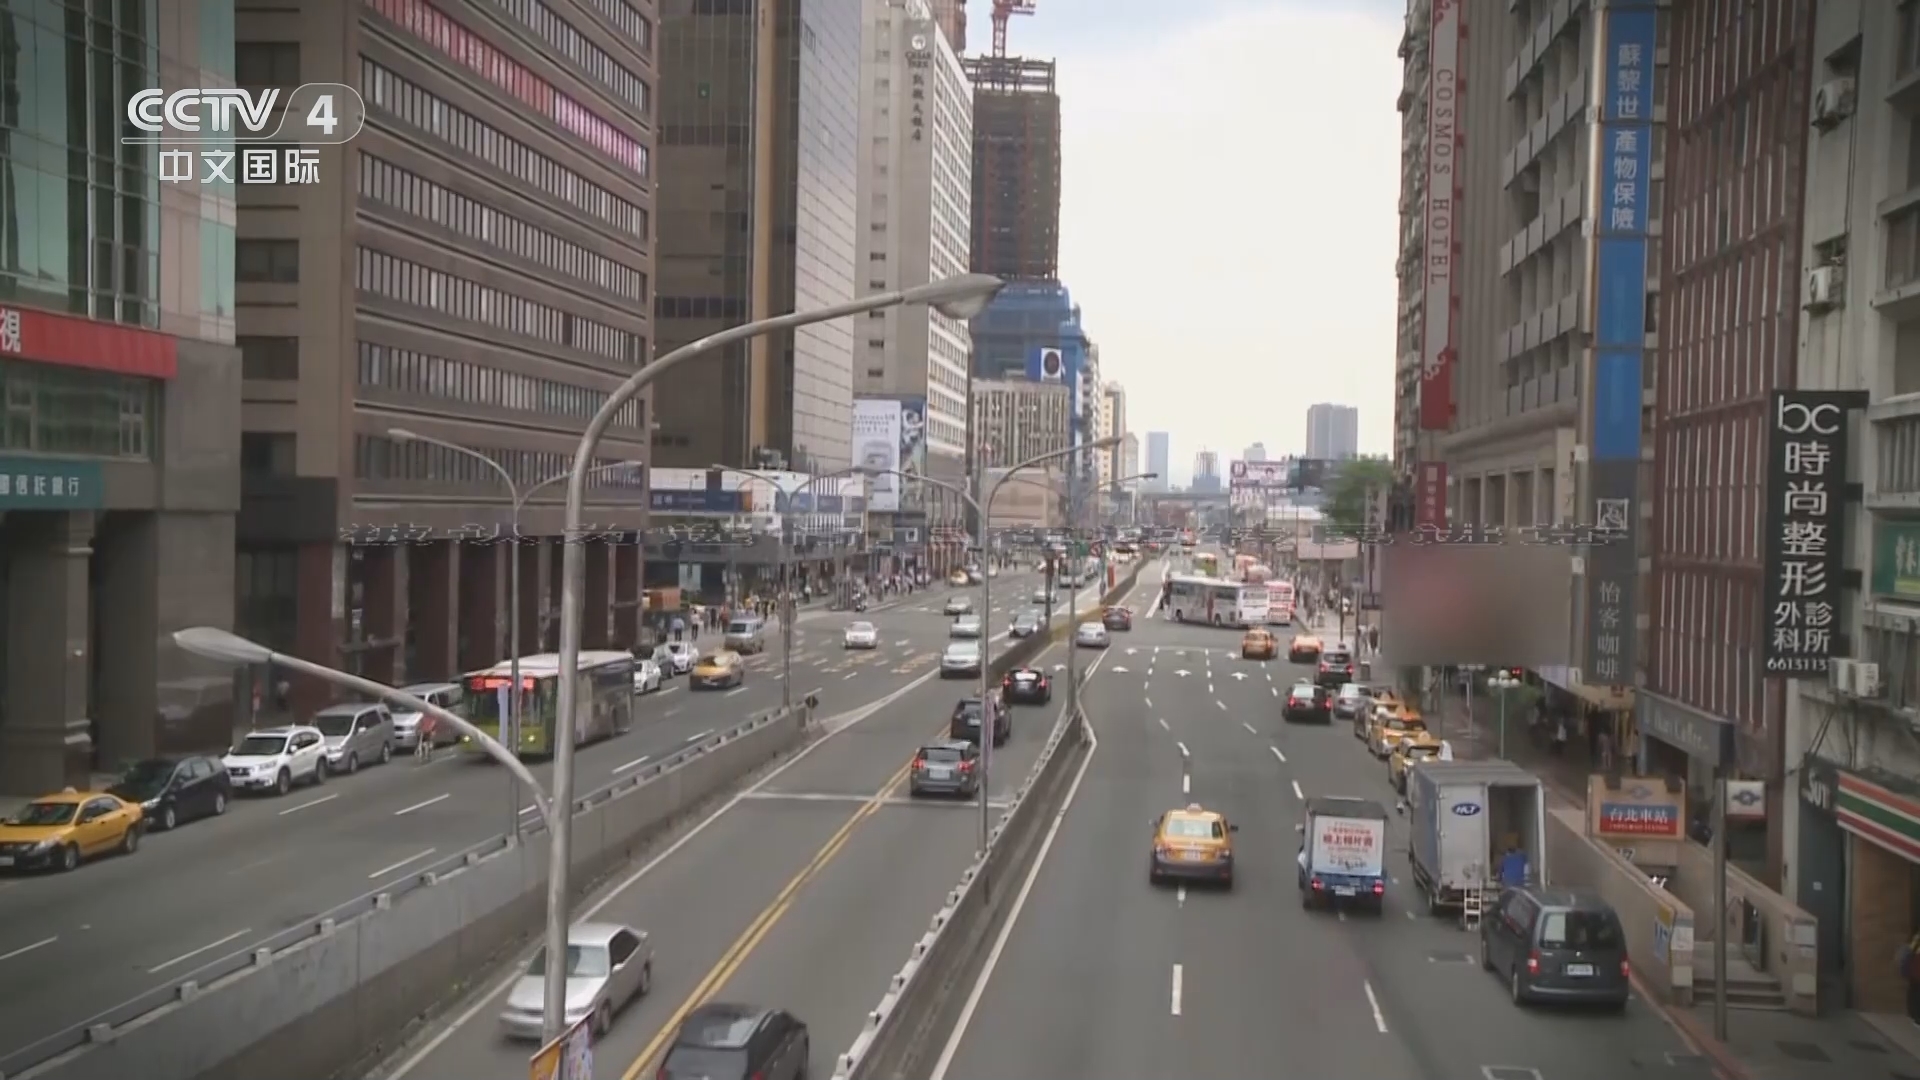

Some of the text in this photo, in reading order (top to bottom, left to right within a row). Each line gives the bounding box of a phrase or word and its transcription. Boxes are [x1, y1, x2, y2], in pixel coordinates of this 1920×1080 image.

[1431, 68, 1453, 285] COSMOS HOTEL
[1612, 44, 1641, 230] 蘇黎世產物保險
[1778, 395, 1840, 434] bc
[1781, 440, 1830, 596] 時尚整形
[1767, 657, 1829, 671] 6613113
[1610, 807, 1668, 825] 台北車站
